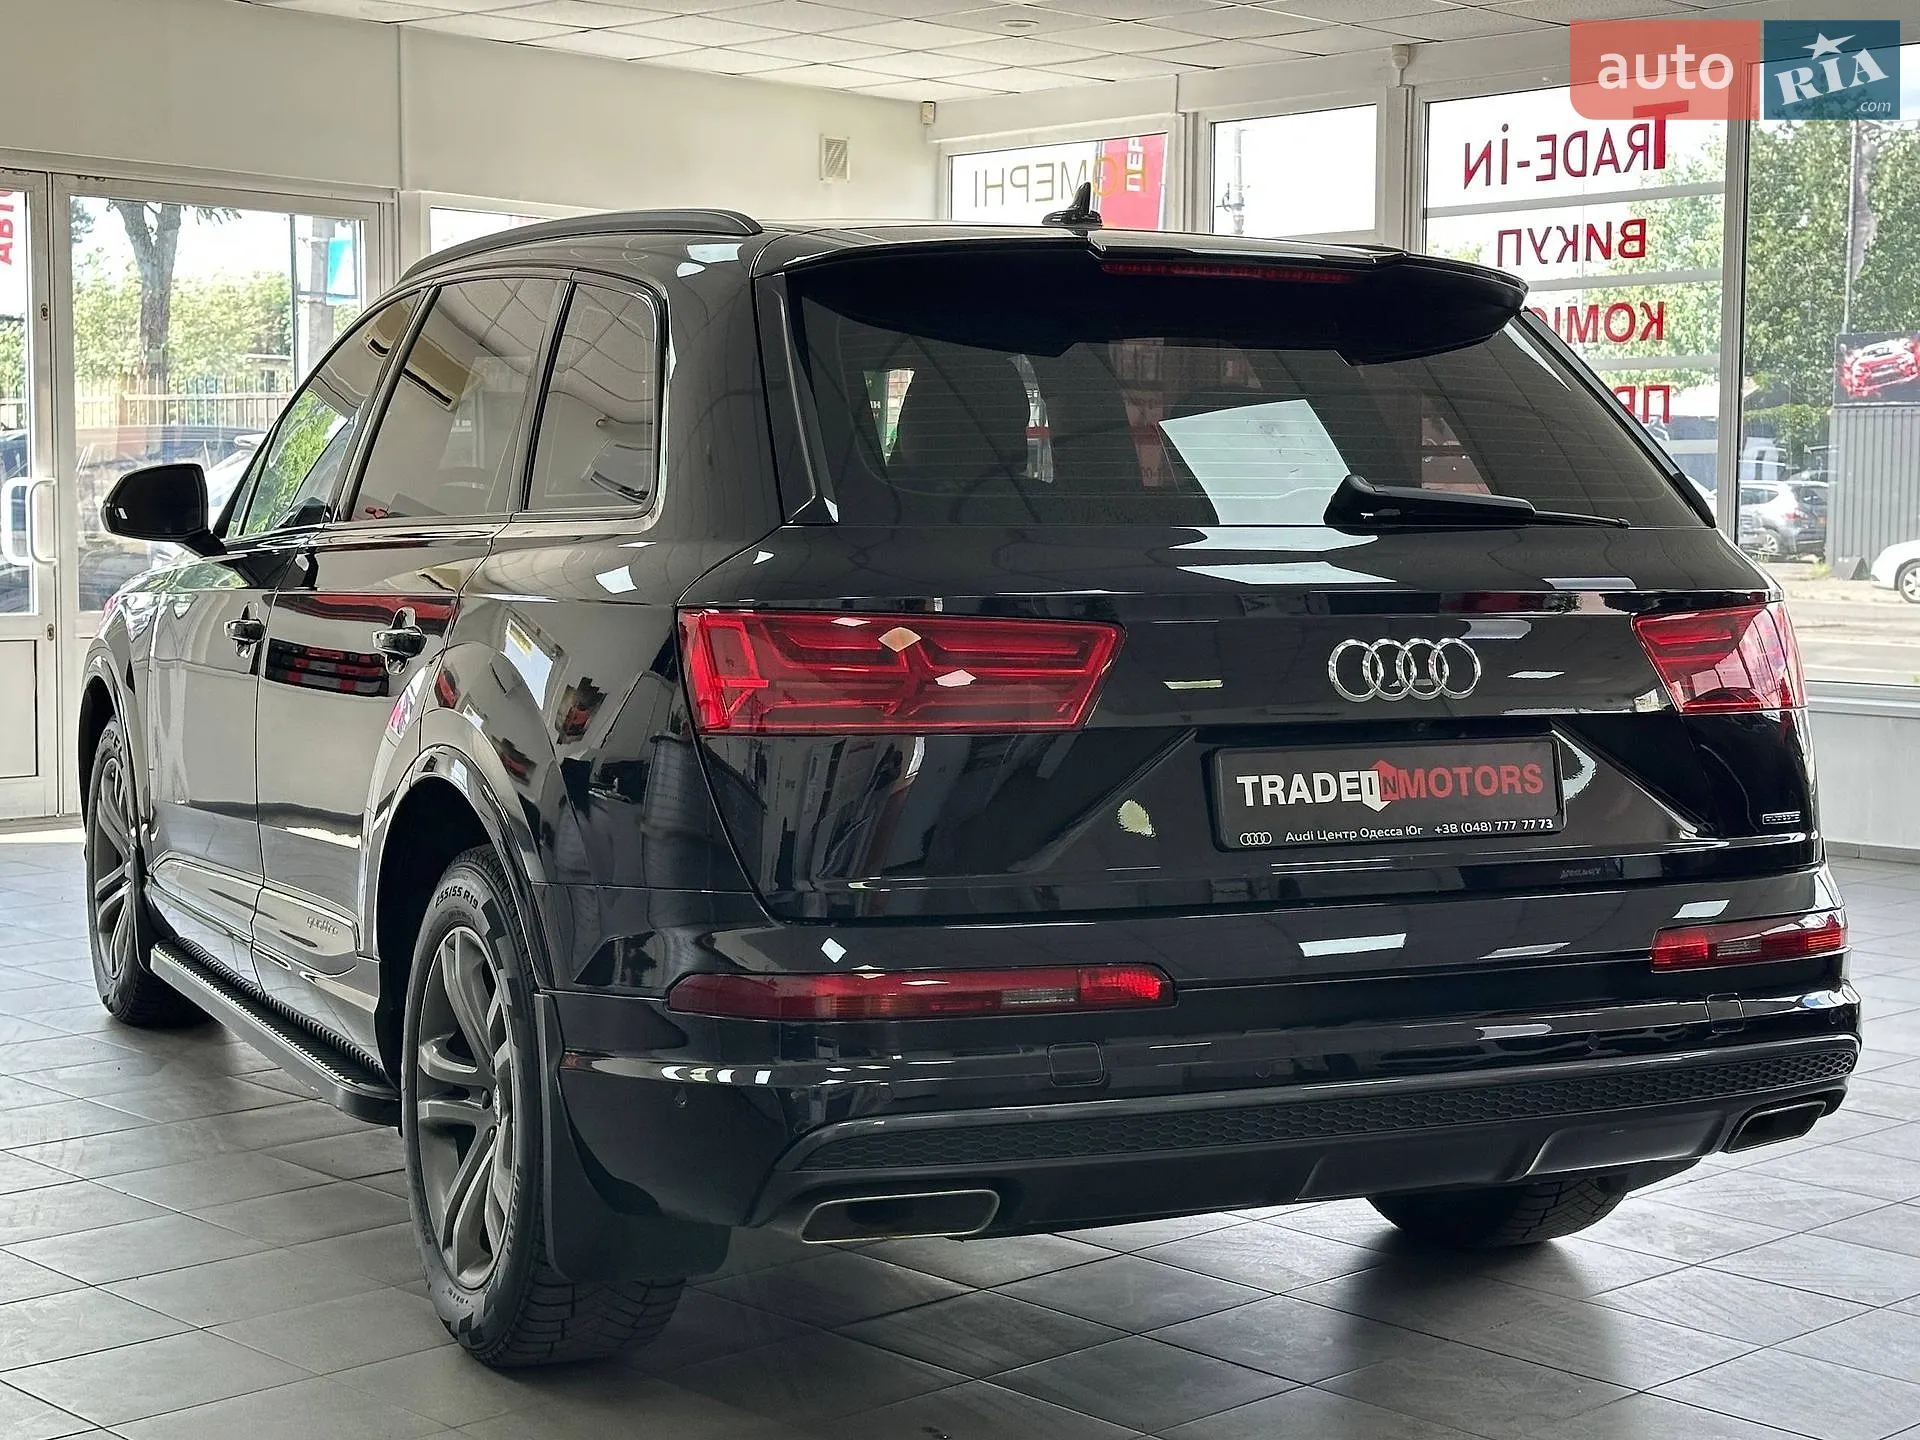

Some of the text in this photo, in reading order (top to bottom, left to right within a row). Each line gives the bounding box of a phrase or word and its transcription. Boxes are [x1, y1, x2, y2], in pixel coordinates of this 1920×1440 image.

[1285, 828, 1314, 842] Audi
[1317, 828, 1357, 843] Центр
[1360, 826, 1402, 841] Одесса
[1405, 825, 1424, 839] Юг
[1434, 823, 1459, 835] +38
[1461, 820, 1493, 835] (048)
[1496, 820, 1517, 832] 777
